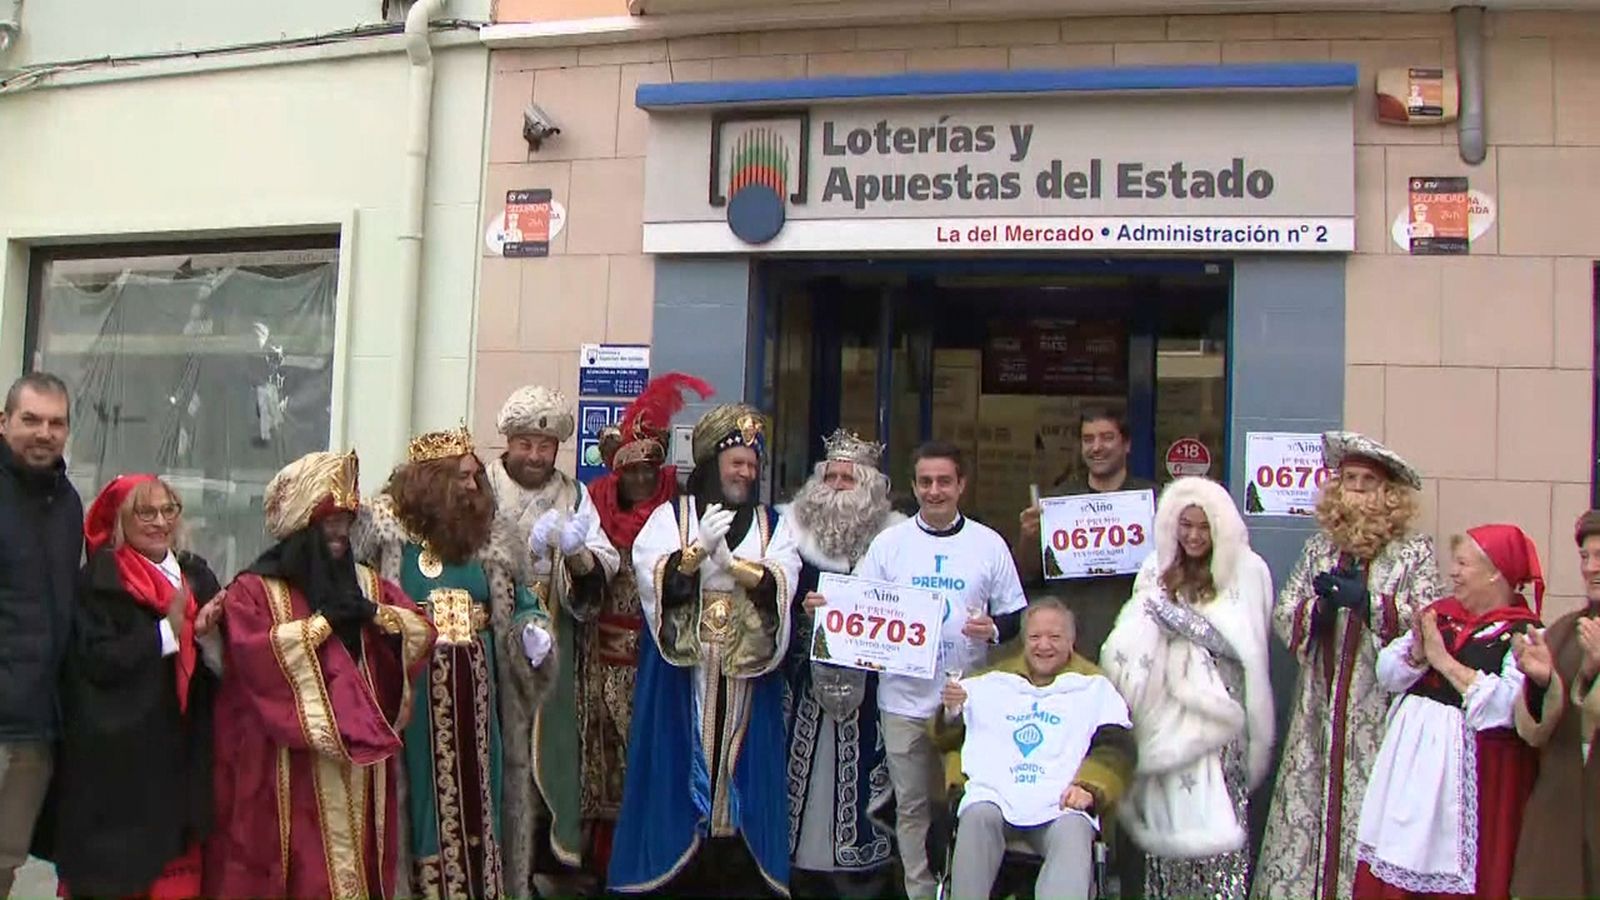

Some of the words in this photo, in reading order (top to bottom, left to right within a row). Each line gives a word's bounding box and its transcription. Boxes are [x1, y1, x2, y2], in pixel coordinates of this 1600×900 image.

[822, 115, 996, 156] Loterías
[1009, 124, 1034, 162] y
[821, 164, 1022, 210] Apuestas
[1036, 159, 1102, 199] del
[1117, 158, 1275, 199] Estado
[937, 226, 960, 243] La
[967, 226, 998, 242] del
[1005, 225, 1094, 242] Mercado
[1116, 224, 1279, 243] Administración
[1316, 225, 1329, 243] 2
[1176, 444, 1200, 459] +18
[1257, 466, 1331, 489] 0670
[1052, 523, 1145, 551] 06703
[911, 576, 965, 591] PREMIO
[825, 609, 927, 647] 06703
